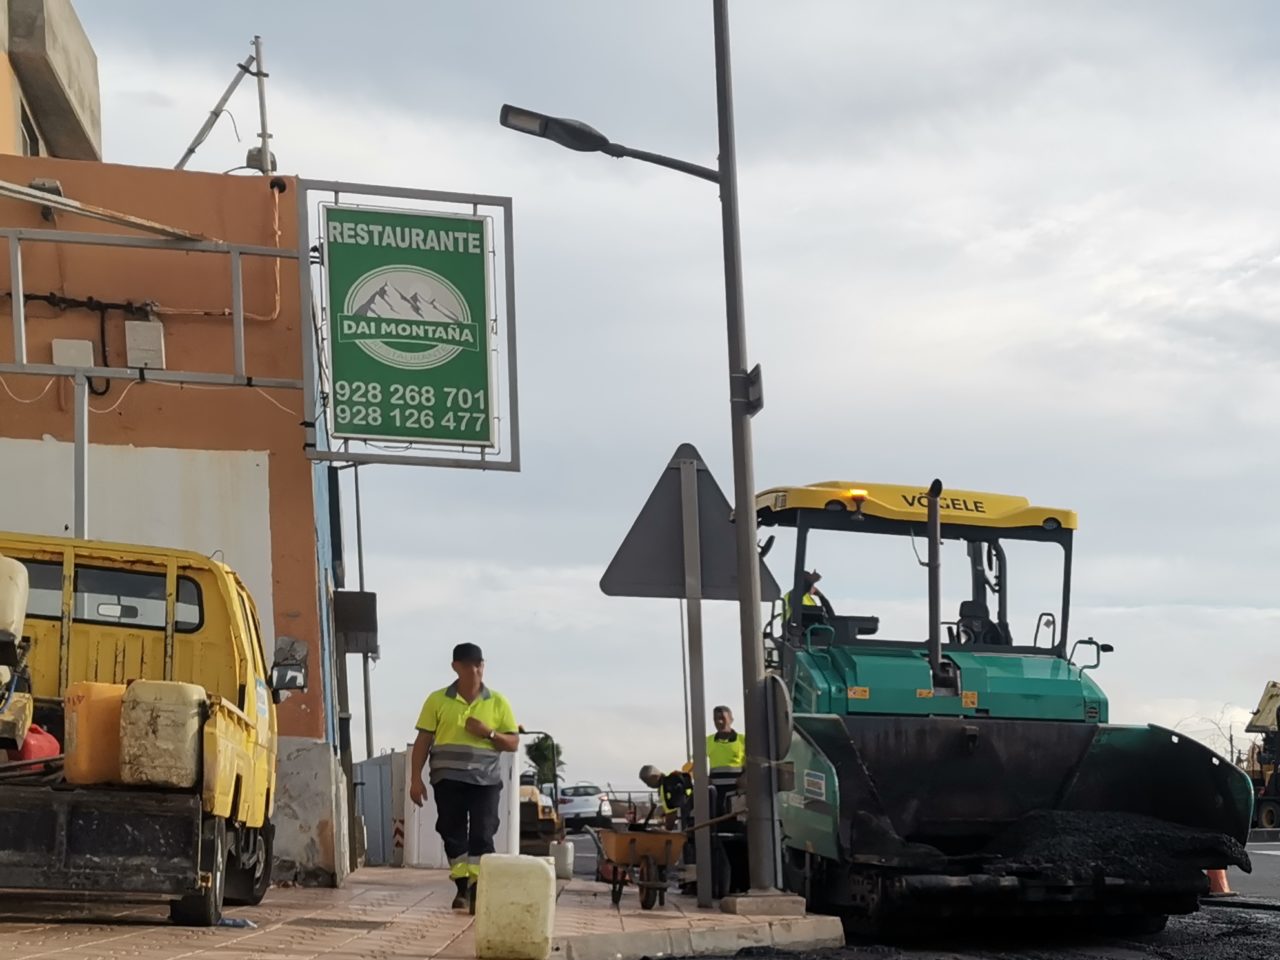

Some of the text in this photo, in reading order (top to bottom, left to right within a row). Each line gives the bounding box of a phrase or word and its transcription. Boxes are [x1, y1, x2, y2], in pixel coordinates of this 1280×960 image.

[328, 221, 481, 254] RESTAURANTE
[343, 320, 474, 342] DAI MONTAÑA
[335, 380, 484, 410] 928 268 701
[336, 404, 486, 432] 928 126 477
